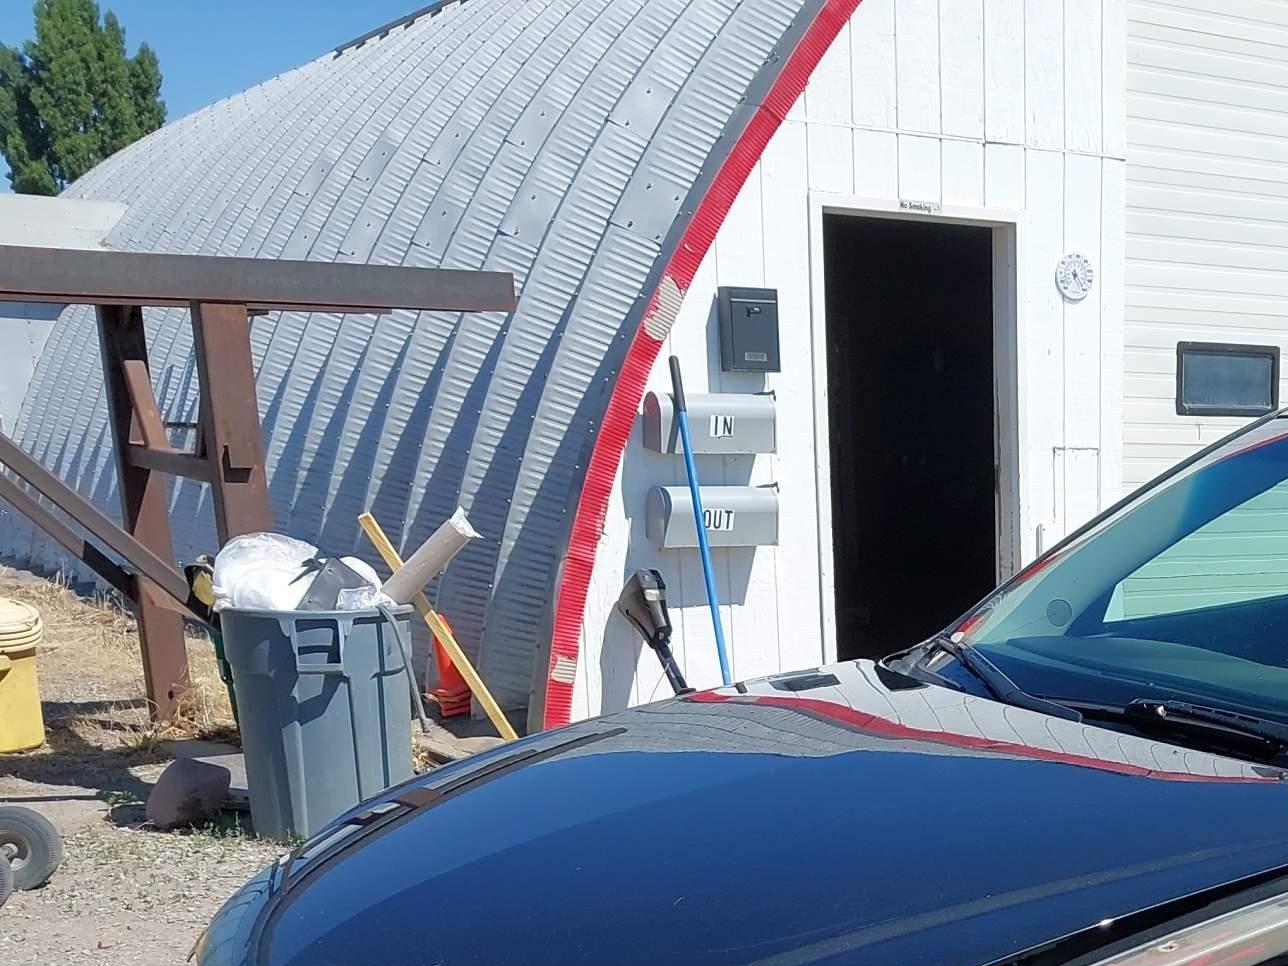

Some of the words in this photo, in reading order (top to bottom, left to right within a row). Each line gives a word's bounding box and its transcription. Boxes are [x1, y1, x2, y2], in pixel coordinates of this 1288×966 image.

[900, 201, 908, 209] No
[714, 416, 732, 435] IN
[704, 510, 734, 529] OUT
